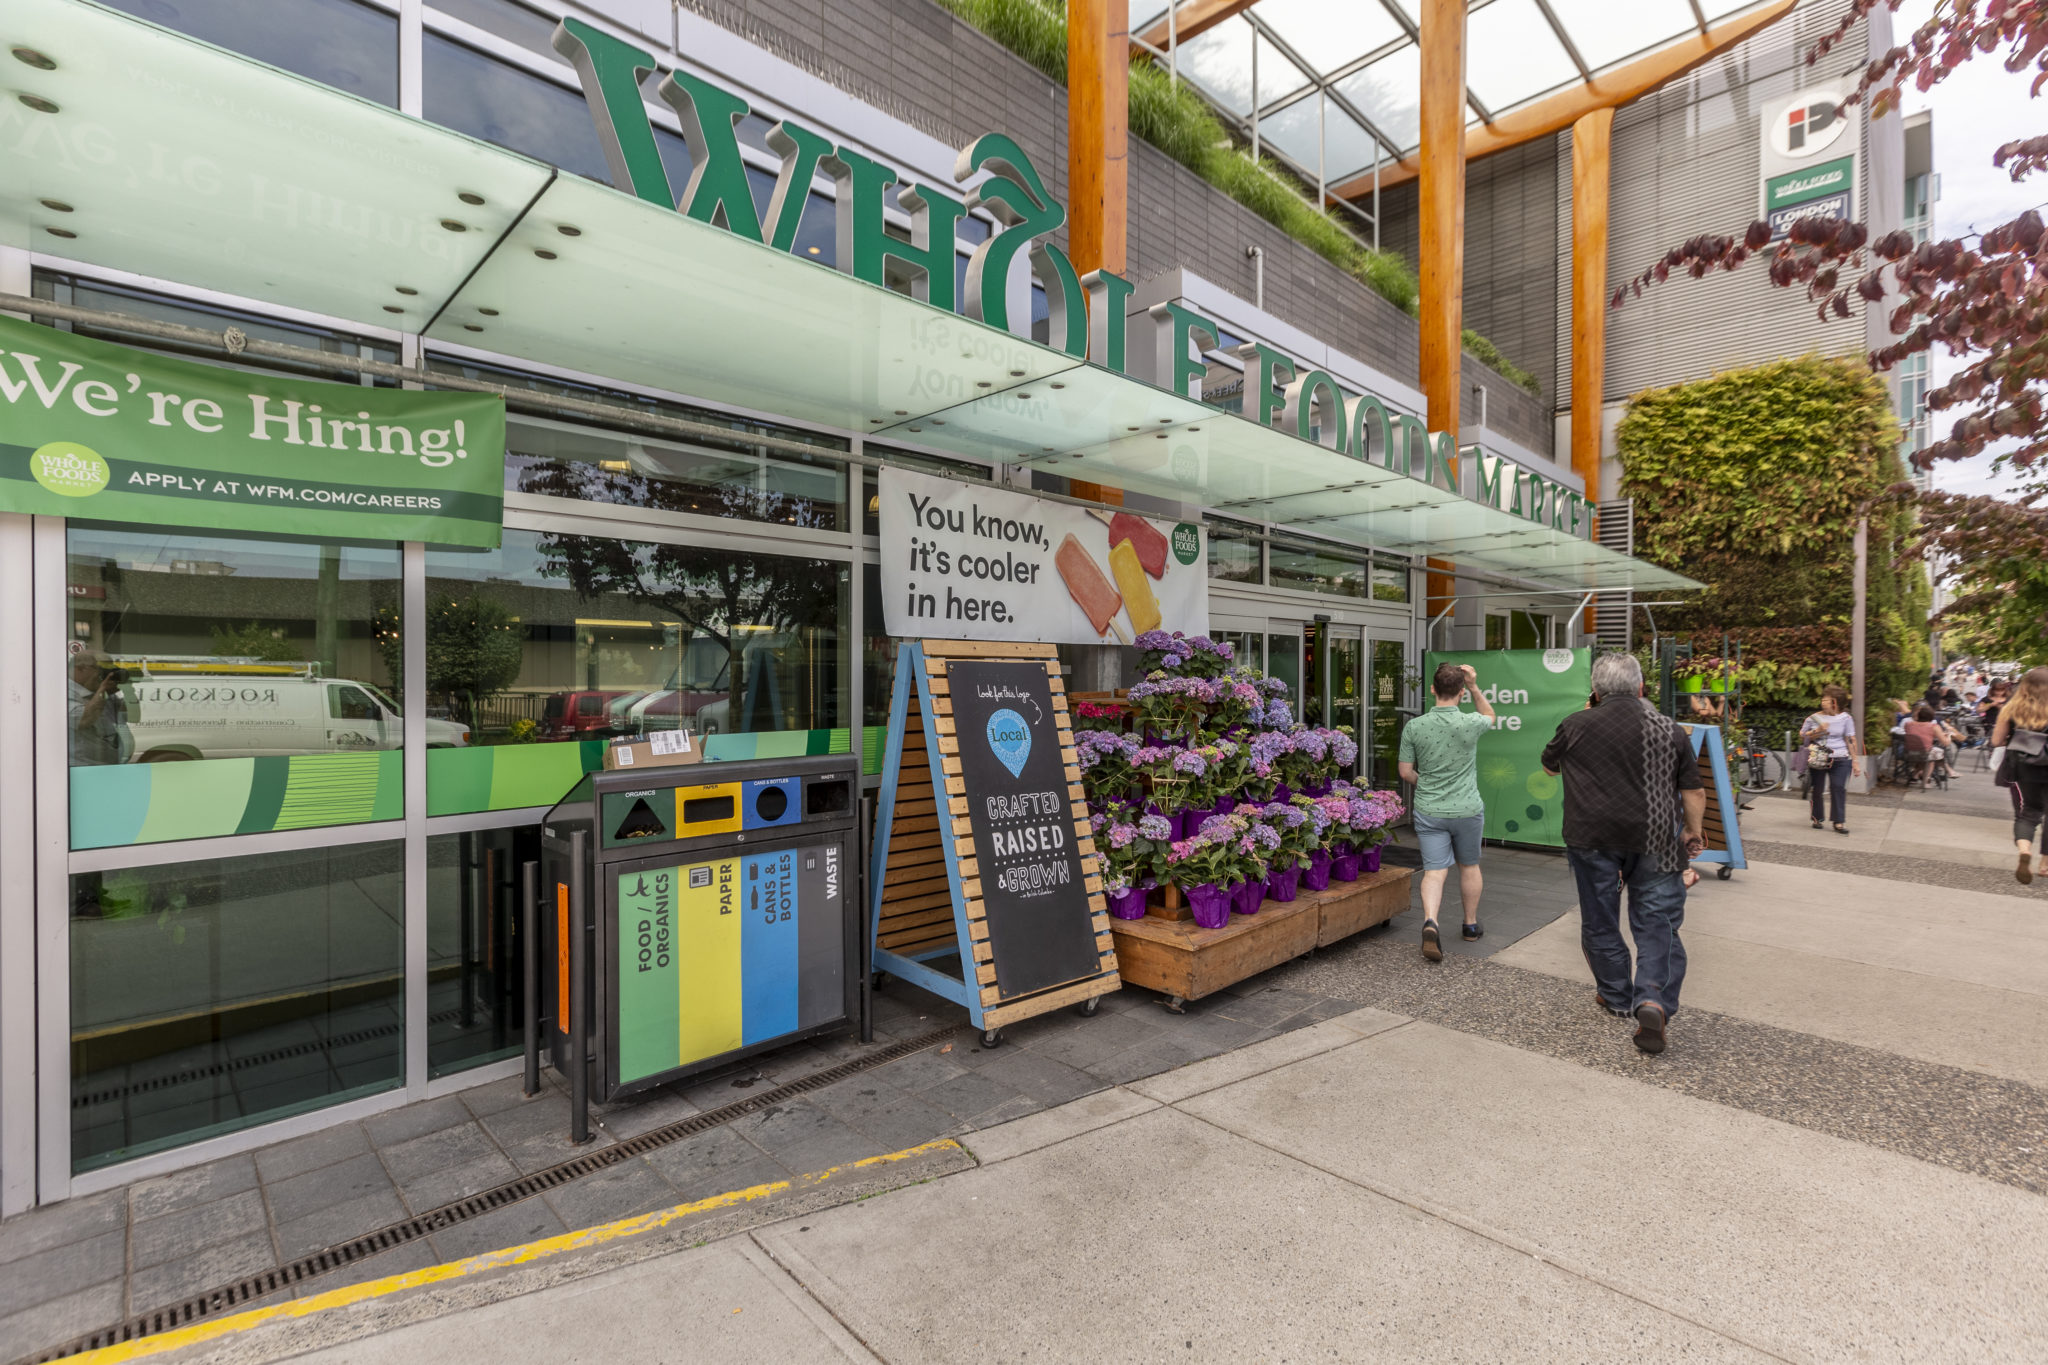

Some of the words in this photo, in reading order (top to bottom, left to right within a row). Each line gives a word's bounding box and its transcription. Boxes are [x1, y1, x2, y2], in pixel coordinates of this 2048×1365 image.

[552, 15, 1220, 398] WHOLE
[1241, 342, 1457, 494] FOODS
[1461, 446, 1597, 541] MARKET
[247, 394, 467, 467] Hiring!
[38, 453, 101, 471] WHOLE
[42, 465, 102, 482] FOODS
[128, 471, 206, 491] APPLY
[213, 480, 240, 495] AT
[246, 483, 442, 509] WFM.COM/CAREERS
[908, 492, 964, 531] You
[972, 503, 1050, 552] know,
[1174, 530, 1196, 543] WHOLE
[1175, 541, 1197, 552] FOODS
[957, 552, 1040, 584] cooler
[908, 582, 936, 618] in
[946, 586, 1014, 623] here.
[991, 727, 1027, 742] Local
[625, 789, 656, 798] ORGANICS
[986, 791, 1060, 820] CRAFTED
[992, 825, 1064, 857] RAISED
[764, 862, 776, 875] &
[780, 854, 792, 921] BOTTLES
[826, 847, 837, 900] WASTE
[720, 863, 732, 915] PAPER
[764, 880, 777, 924] CANS
[655, 873, 670, 968] ORGANICS
[638, 919, 652, 973] FOOD
